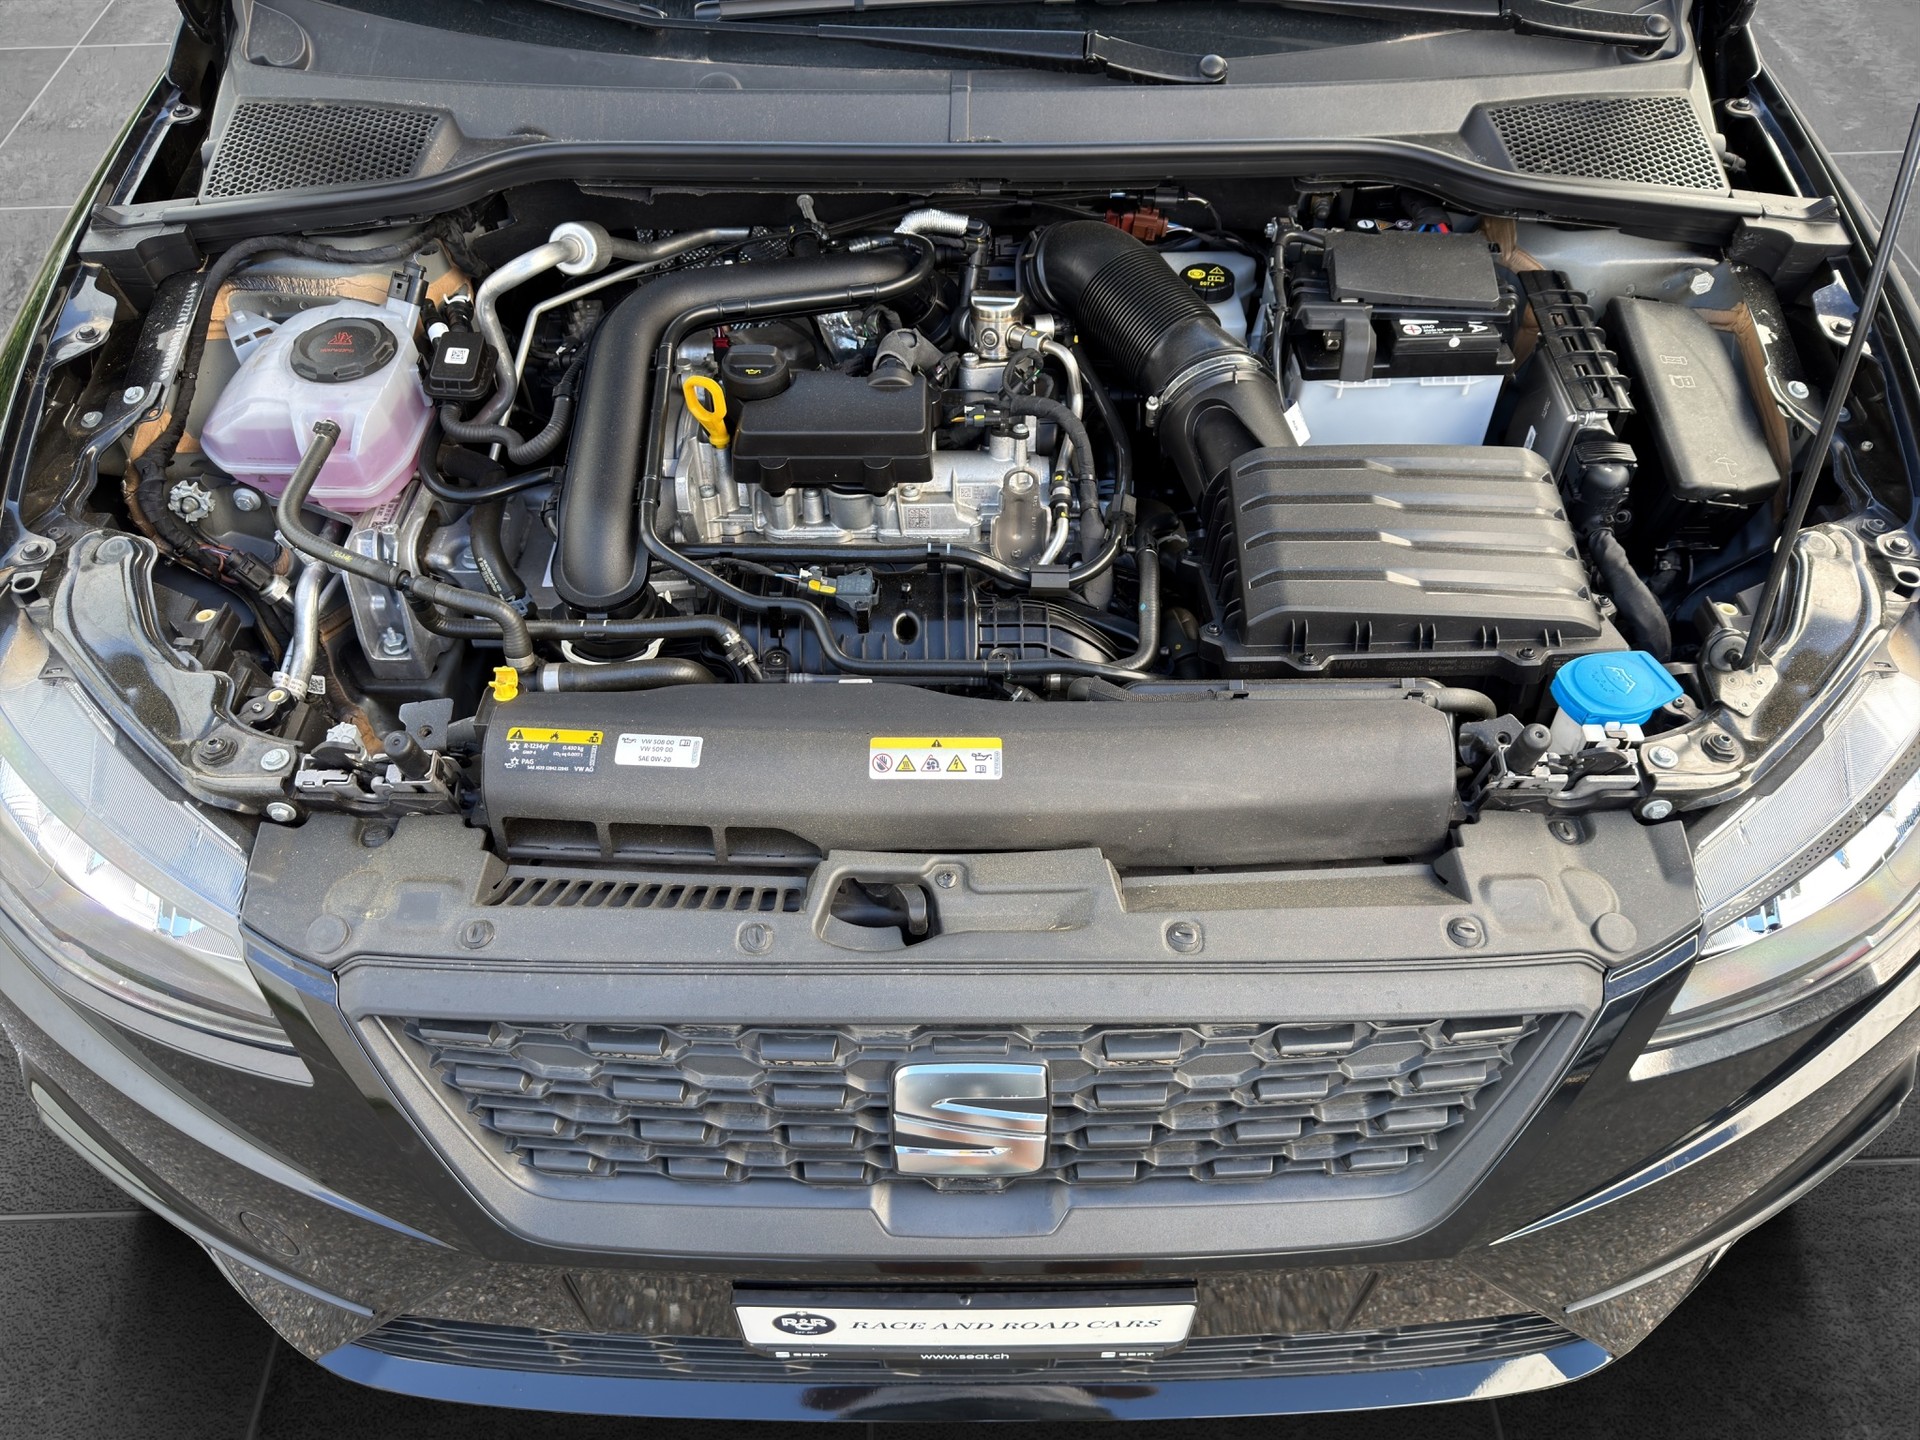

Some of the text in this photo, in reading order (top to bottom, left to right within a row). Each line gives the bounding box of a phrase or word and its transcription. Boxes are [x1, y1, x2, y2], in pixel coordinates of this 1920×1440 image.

[523, 743, 549, 751] R-1234yf
[850, 1320, 1162, 1330] RACE AND ROAD CARS
[920, 1352, 1010, 1360] www.seat.ch
